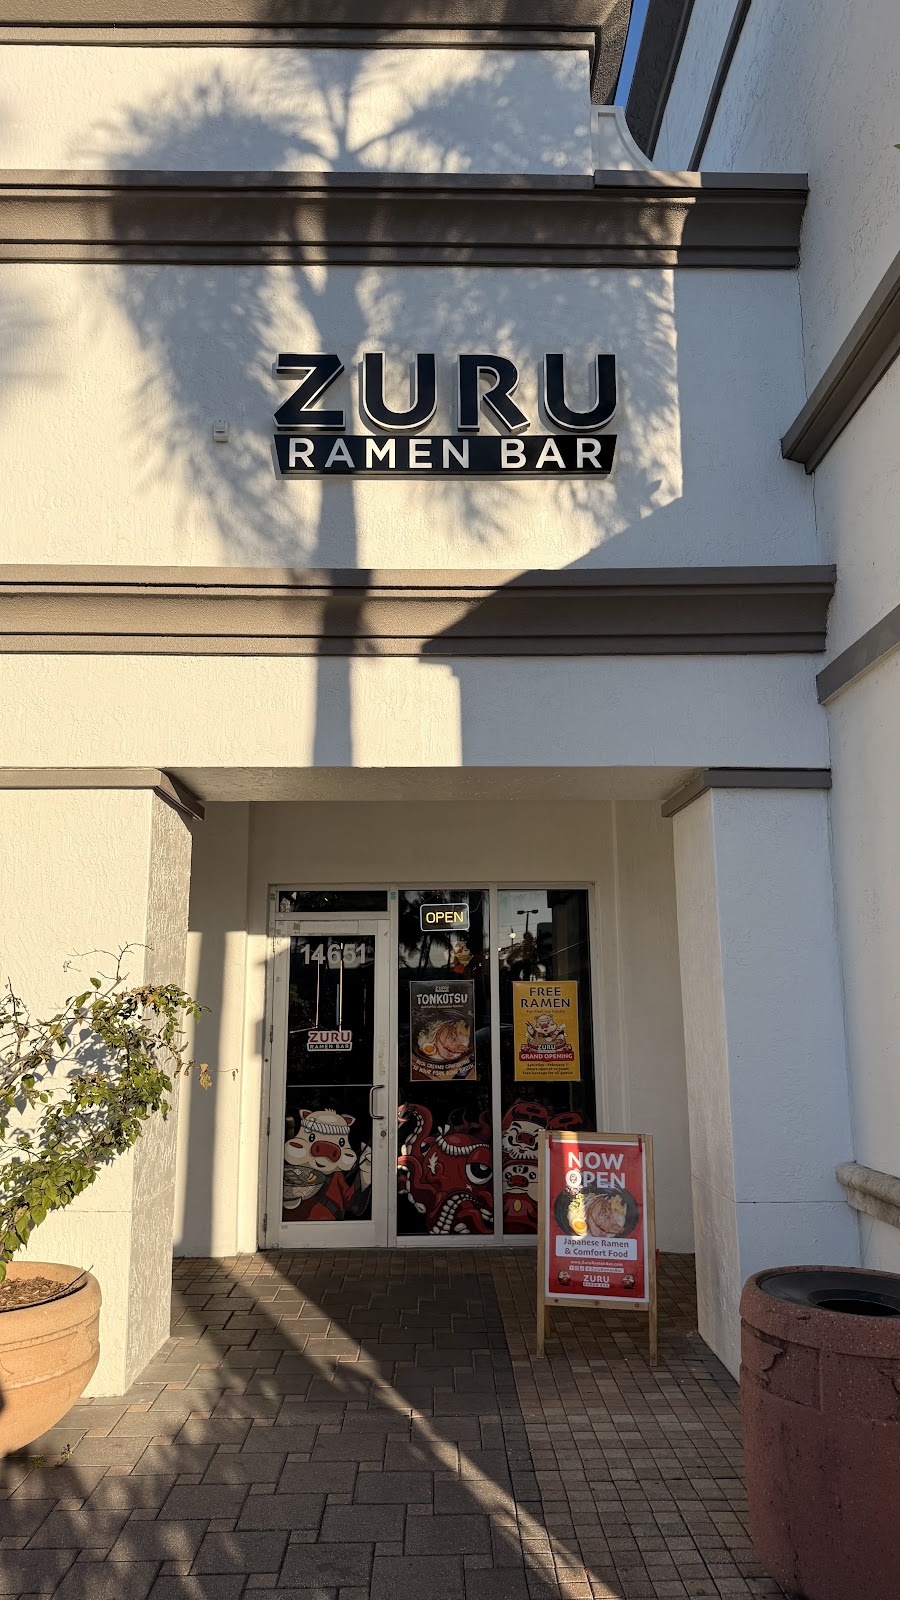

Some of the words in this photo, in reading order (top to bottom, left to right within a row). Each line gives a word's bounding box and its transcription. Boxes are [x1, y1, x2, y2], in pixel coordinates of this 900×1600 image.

[272, 351, 617, 432] ZURU
[288, 437, 470, 468] RAMEN
[500, 437, 602, 468] BAR
[425, 911, 464, 924] OPEN
[300, 943, 366, 965] 14651
[529, 986, 562, 997] FREE
[416, 993, 468, 1005] TONKOTSU
[520, 998, 570, 1008] RAMEN
[309, 1031, 351, 1043] ZURU
[568, 1151, 624, 1170] NOW
[565, 1169, 626, 1189] OPEN
[563, 1238, 600, 1247] Japanese
[601, 1239, 629, 1248] Ramen
[564, 1247, 572, 1255] &
[573, 1248, 607, 1257] Comfort
[608, 1249, 629, 1258] Food
[583, 1274, 610, 1283] ZURU
